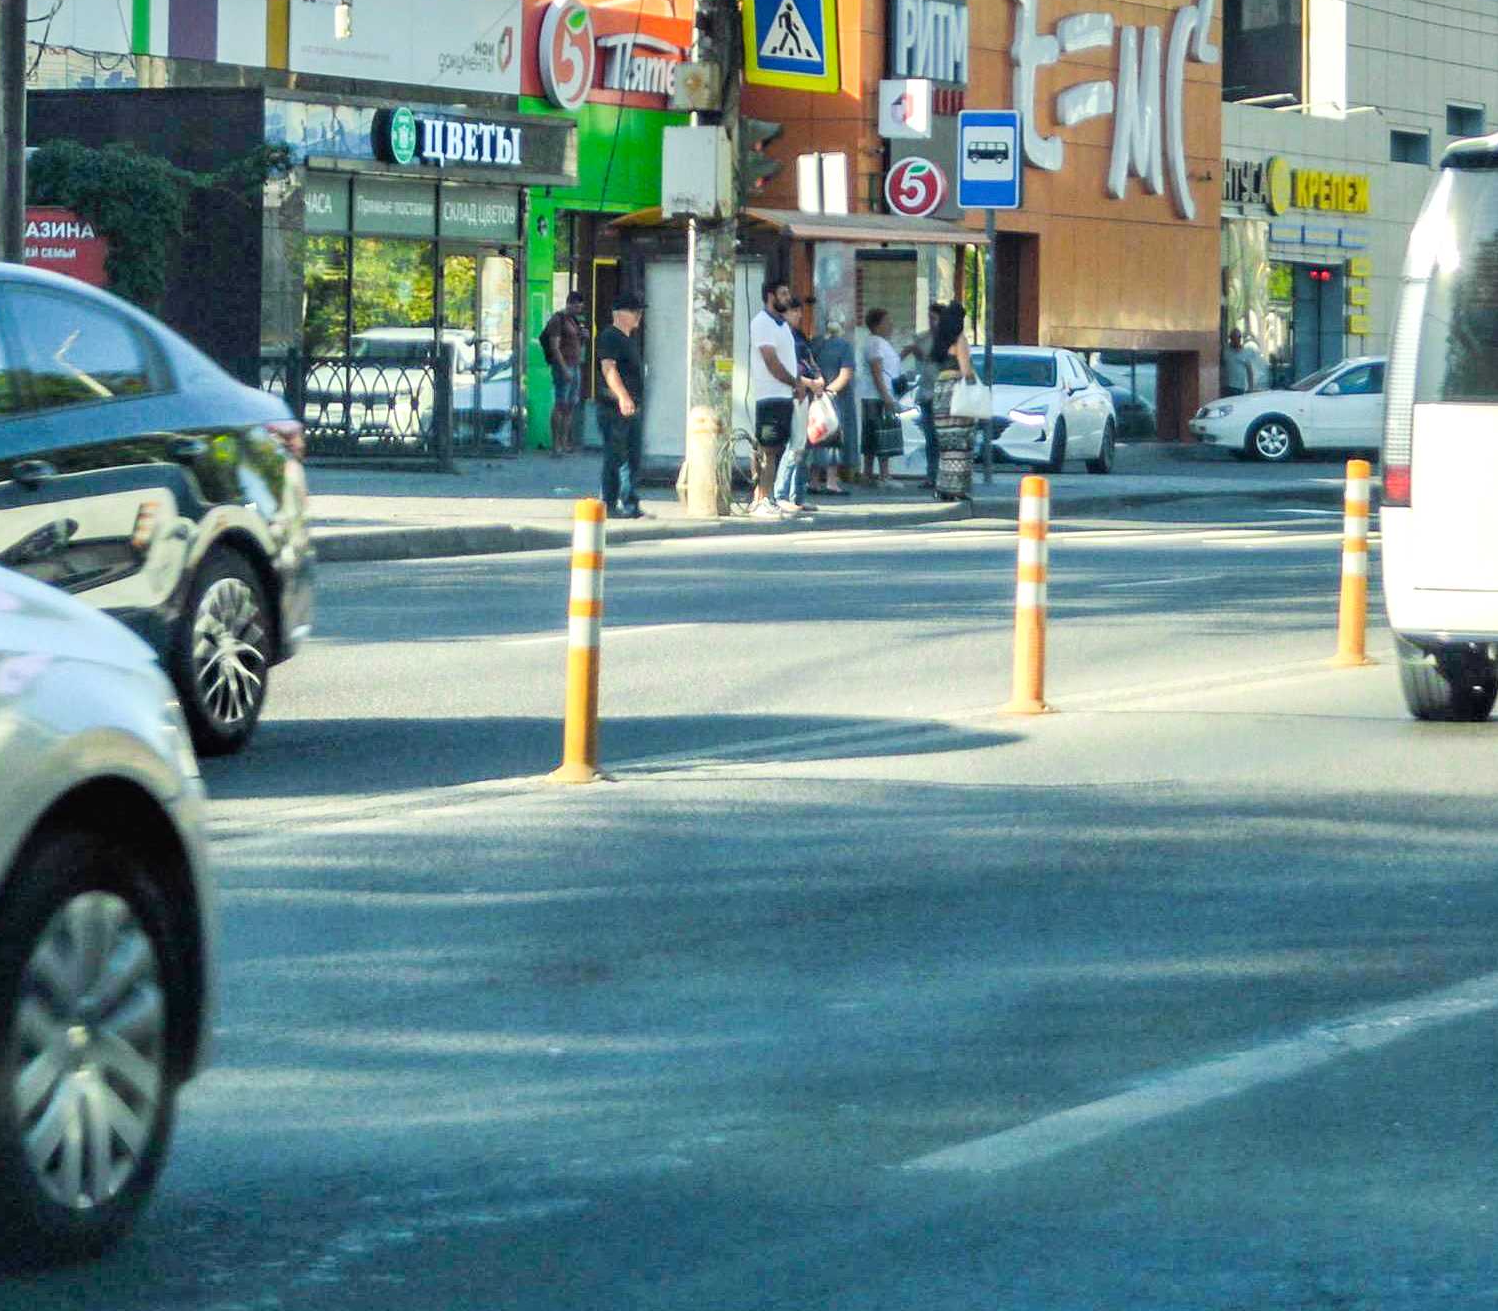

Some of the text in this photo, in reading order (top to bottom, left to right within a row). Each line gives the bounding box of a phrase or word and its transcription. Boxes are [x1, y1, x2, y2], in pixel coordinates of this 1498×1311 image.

[422, 118, 522, 168] ЦВЕТЫ
[898, 164, 928, 208] 5
[1296, 168, 1370, 213] КРЕПЕЖ
[22, 220, 95, 239] АЗИНА
[443, 201, 517, 227] СКЛАД ЦВЕТОВ
[41, 247, 77, 259] СЕМЬИ
